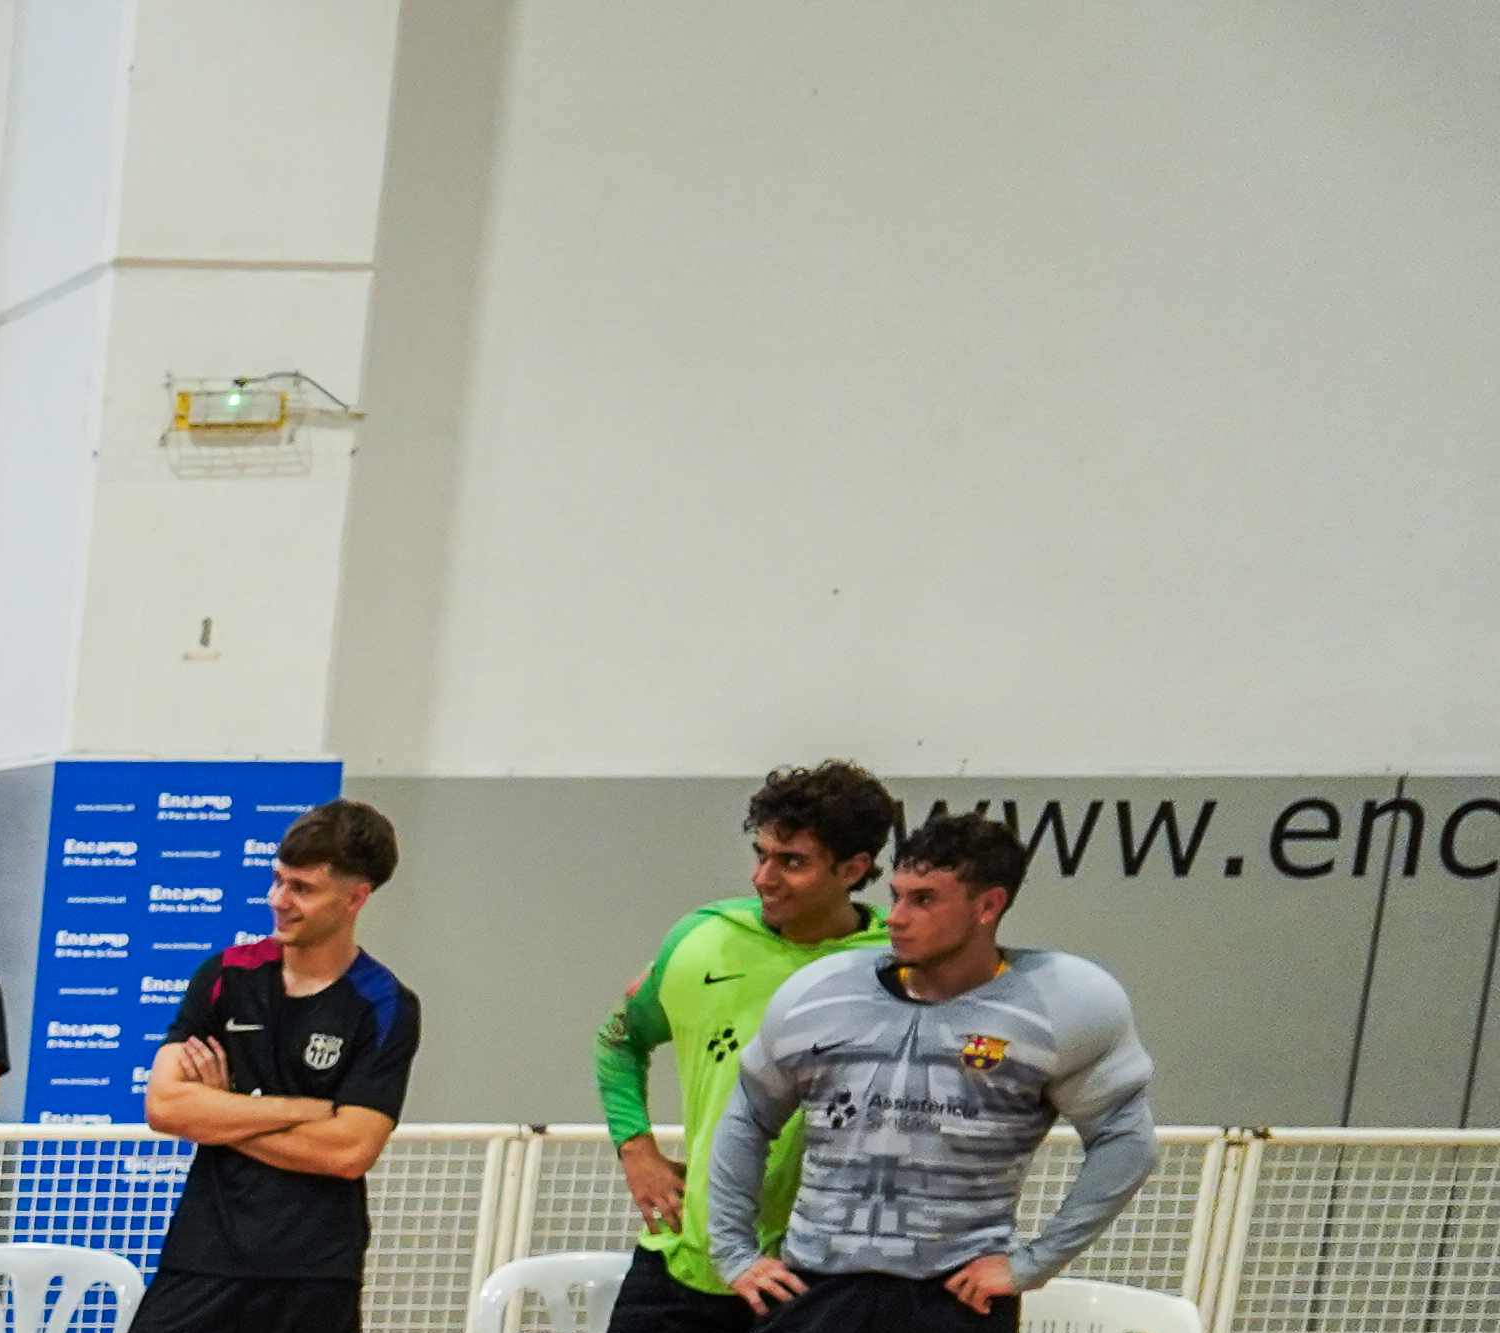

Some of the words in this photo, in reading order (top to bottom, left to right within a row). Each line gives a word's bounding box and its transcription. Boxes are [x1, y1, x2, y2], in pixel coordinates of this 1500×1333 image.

[158, 792, 233, 811] Encamp
[63, 838, 138, 856] Encamp
[149, 884, 223, 903] Encamp
[55, 930, 130, 948] Encamp
[47, 1021, 121, 1039] Encamp
